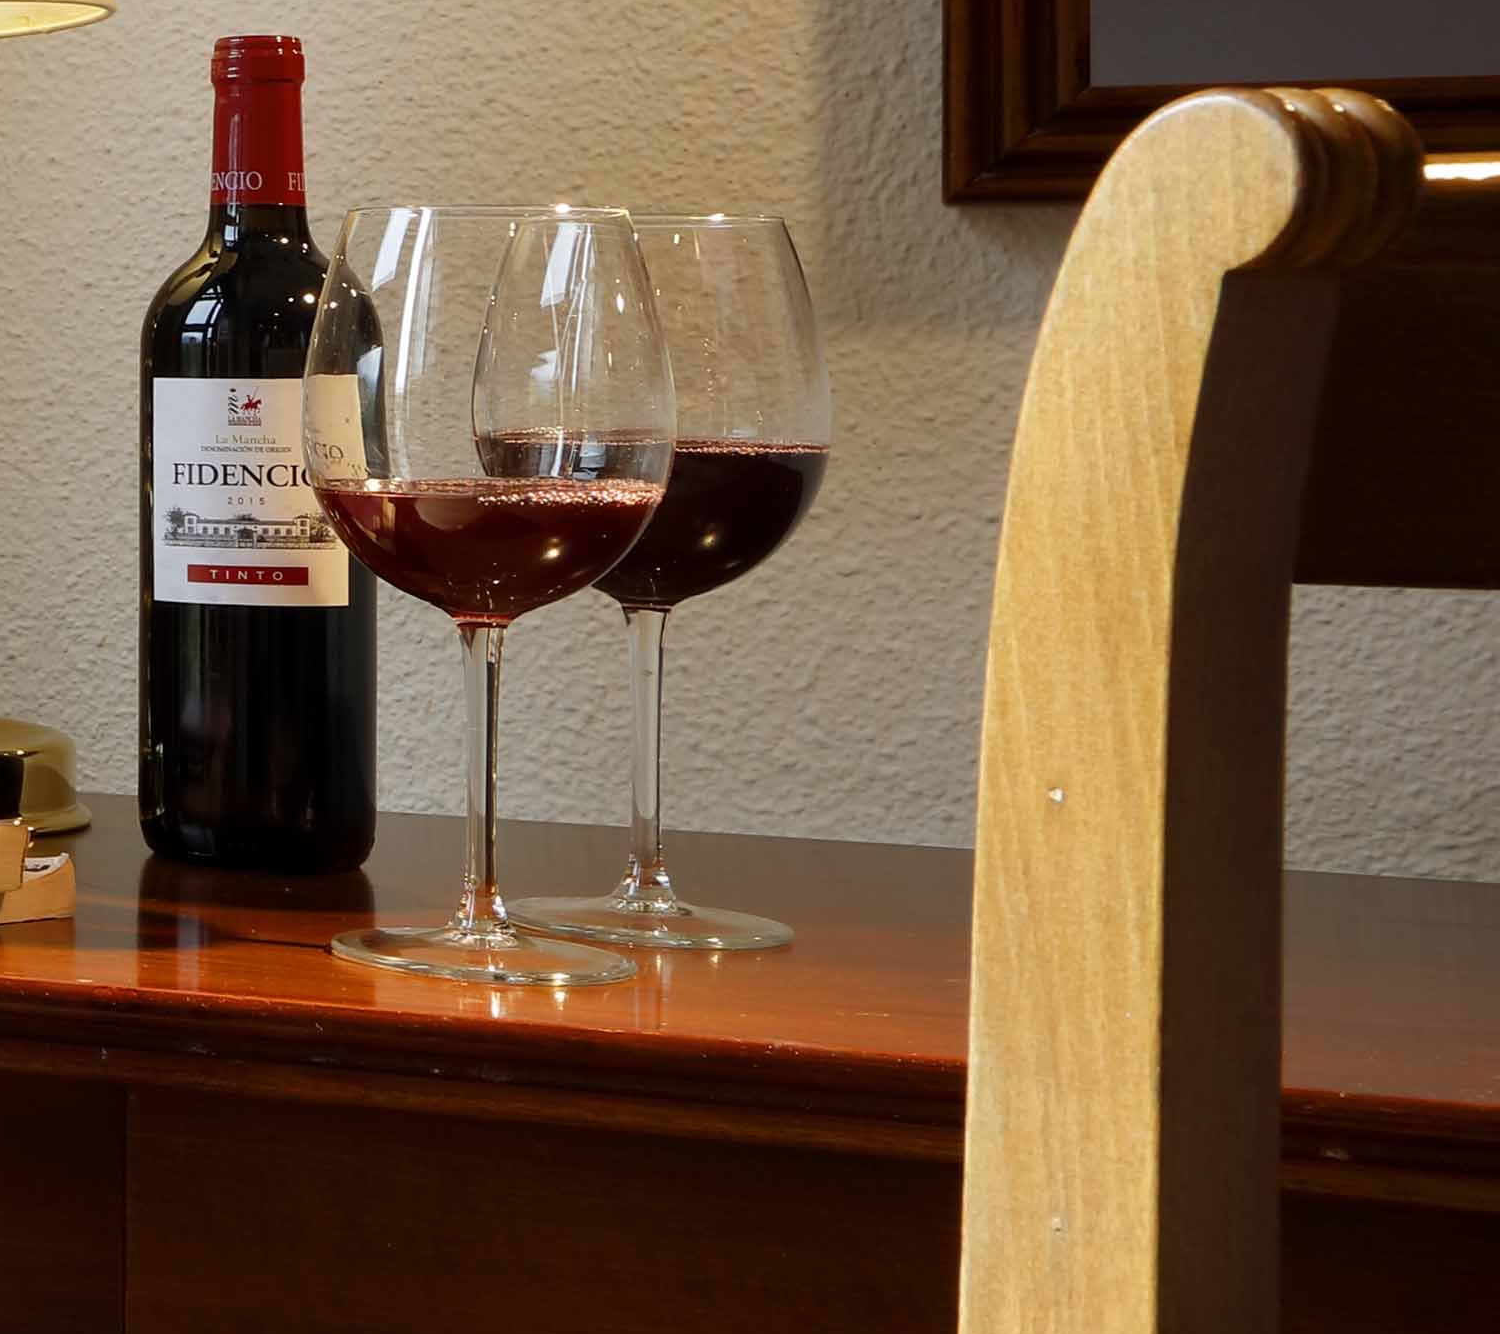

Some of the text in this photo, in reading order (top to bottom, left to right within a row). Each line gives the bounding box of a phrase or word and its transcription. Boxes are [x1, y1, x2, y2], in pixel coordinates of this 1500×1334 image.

[215, 434, 276, 444] La Mancha
[228, 497, 266, 506] 2015
[210, 569, 284, 581] TINTO
